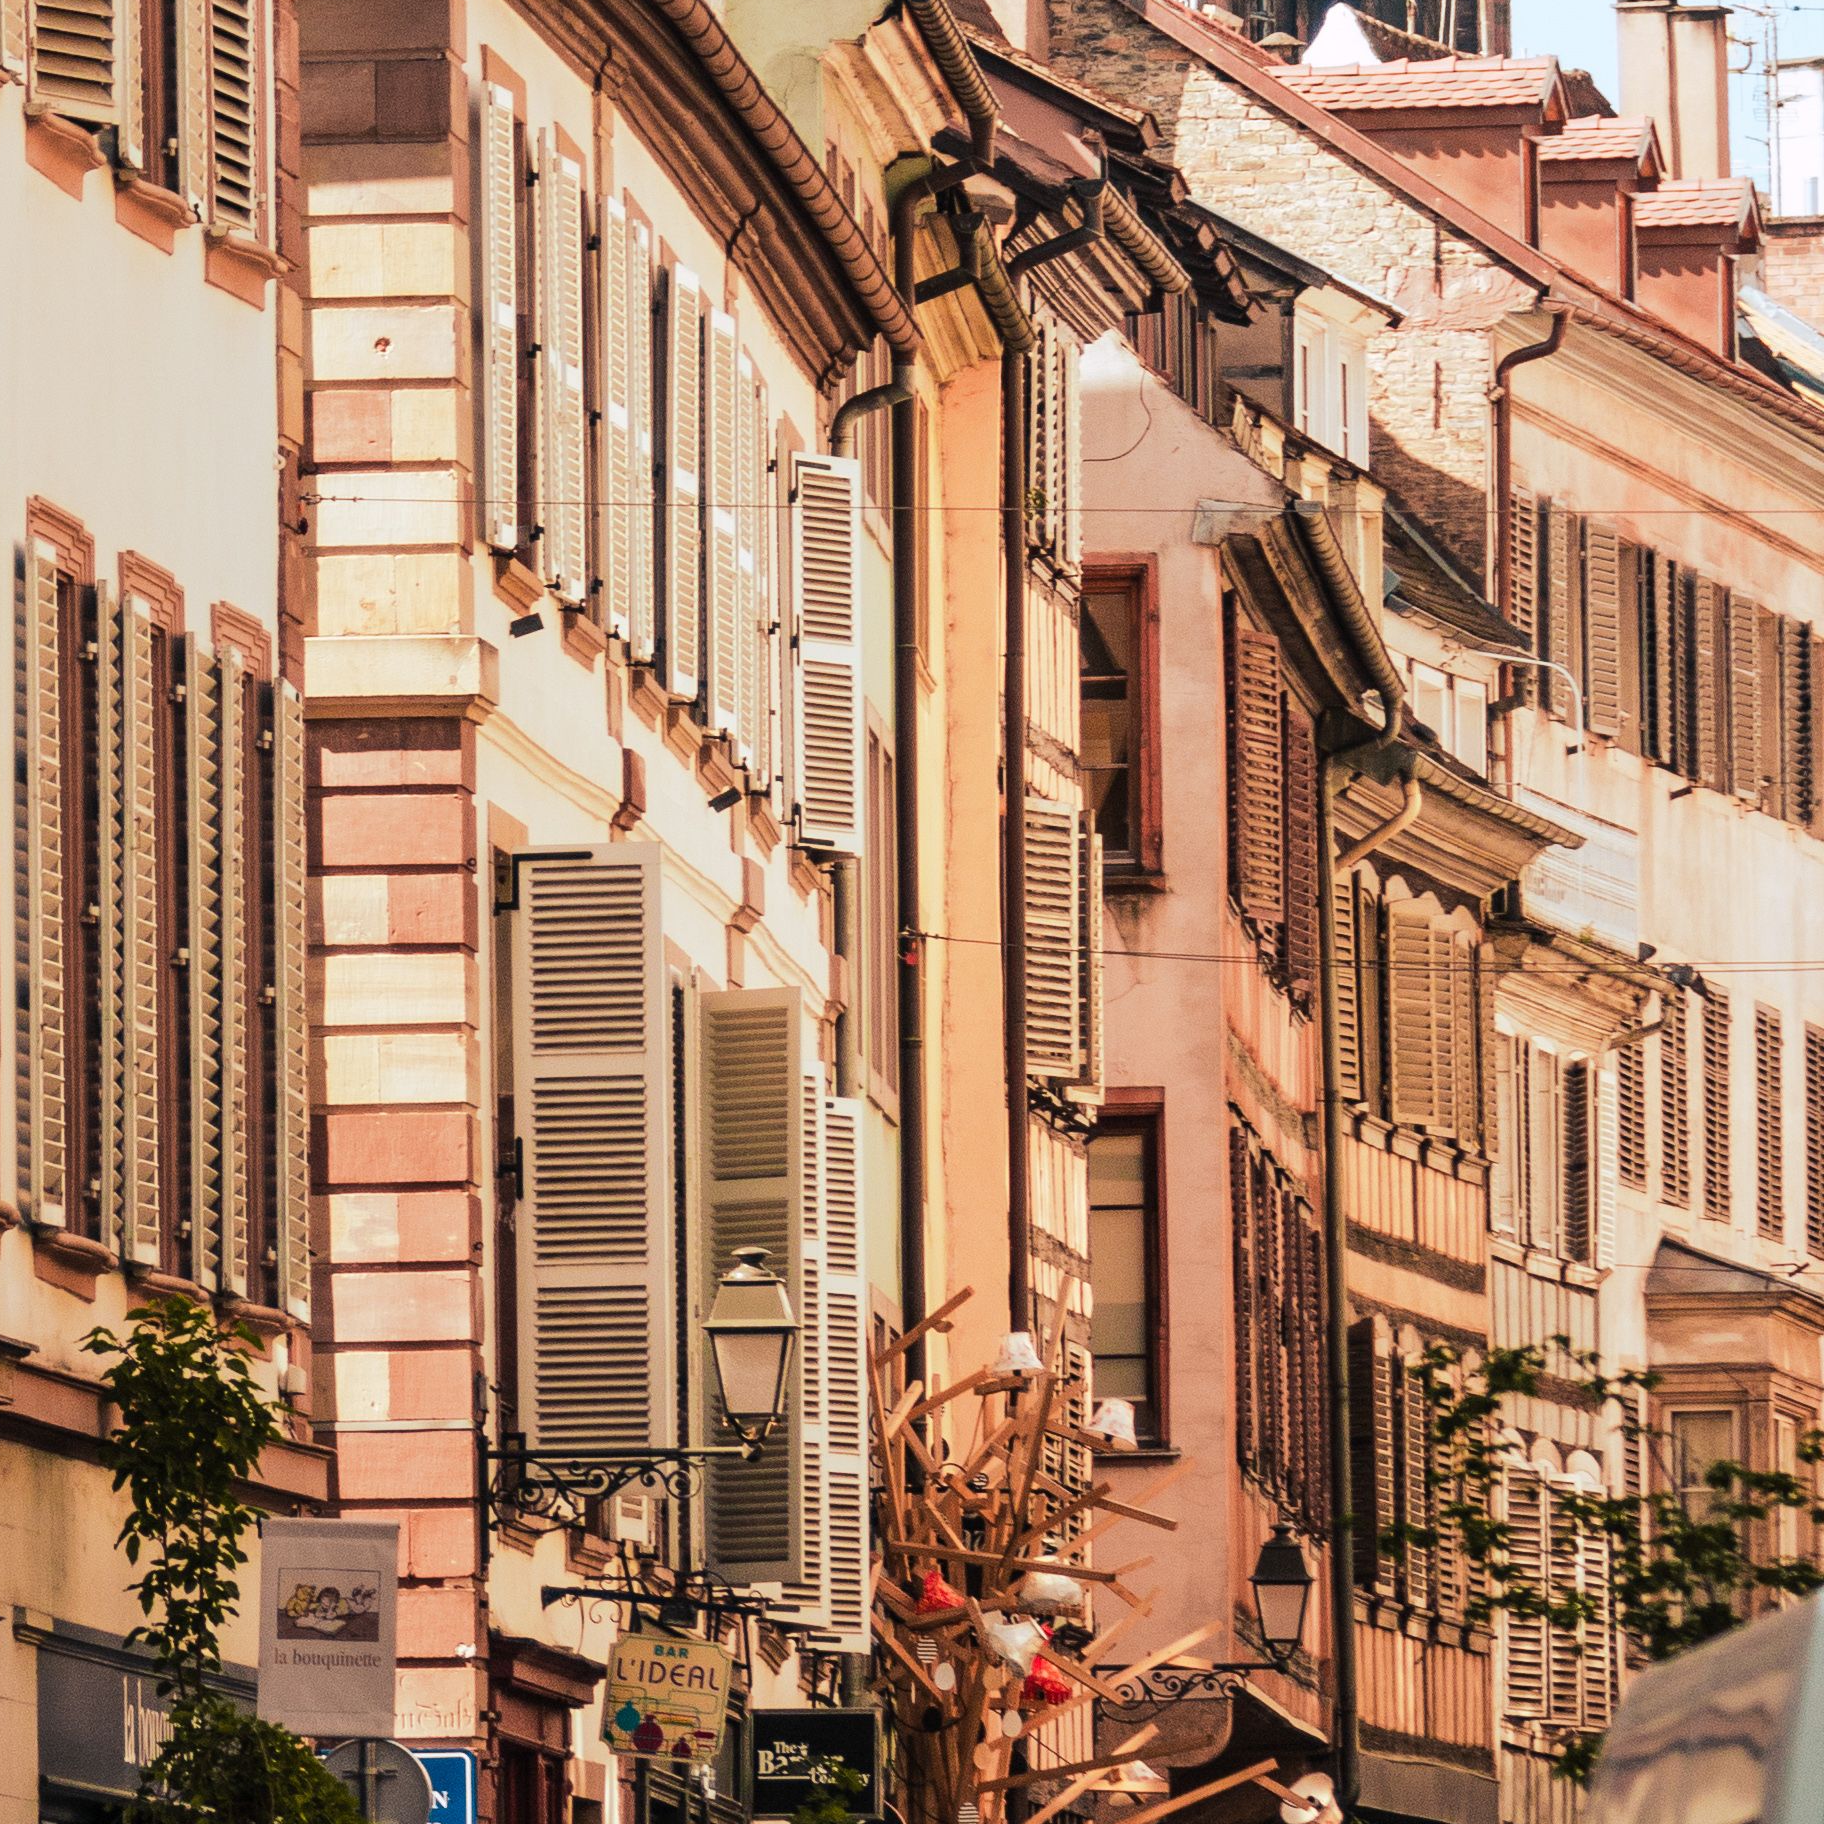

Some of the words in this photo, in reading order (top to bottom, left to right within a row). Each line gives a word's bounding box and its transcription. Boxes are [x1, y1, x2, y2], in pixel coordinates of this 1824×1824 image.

[653, 1644, 689, 1658] BAR
[274, 1648, 288, 1665] la
[292, 1649, 381, 1670] bouquinette
[773, 1740, 798, 1754] The
